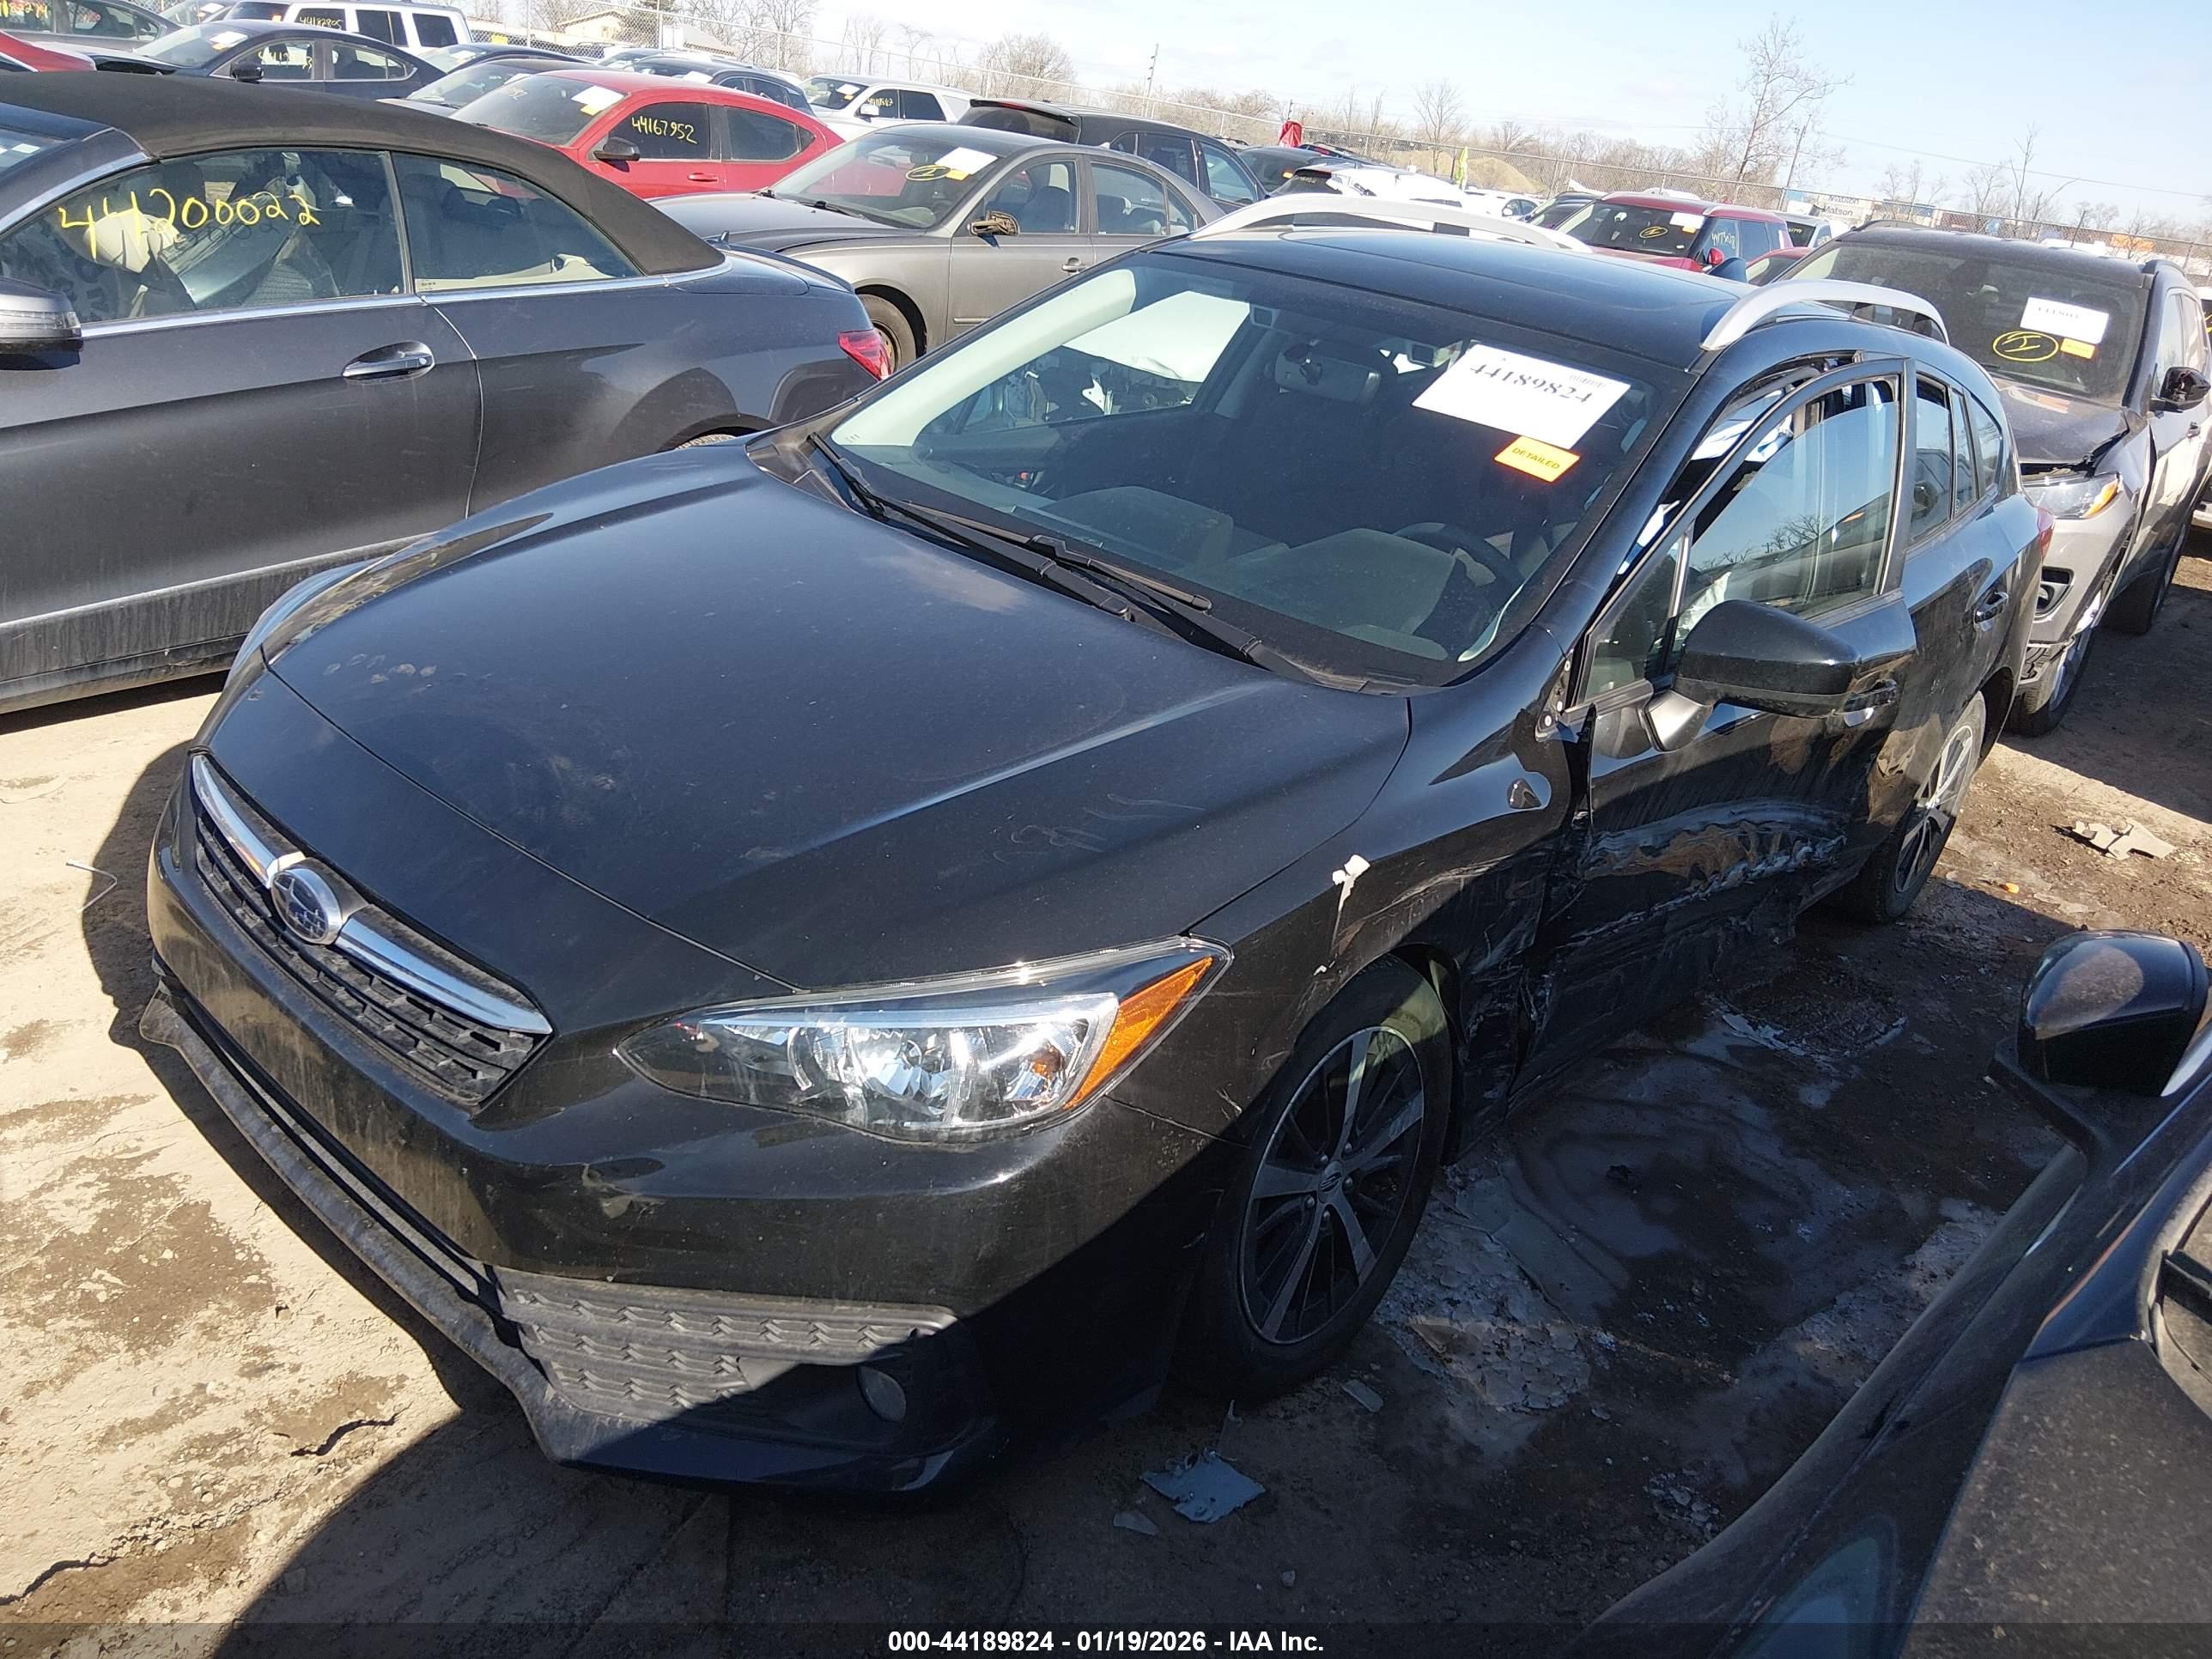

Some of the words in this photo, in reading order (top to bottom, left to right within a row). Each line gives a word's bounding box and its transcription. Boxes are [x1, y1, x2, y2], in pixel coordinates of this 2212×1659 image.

[631, 114, 698, 144] 44167952
[58, 188, 320, 263] 44200022
[1469, 363, 1593, 404] 44189824
[1512, 447, 1560, 470] DETAILED
